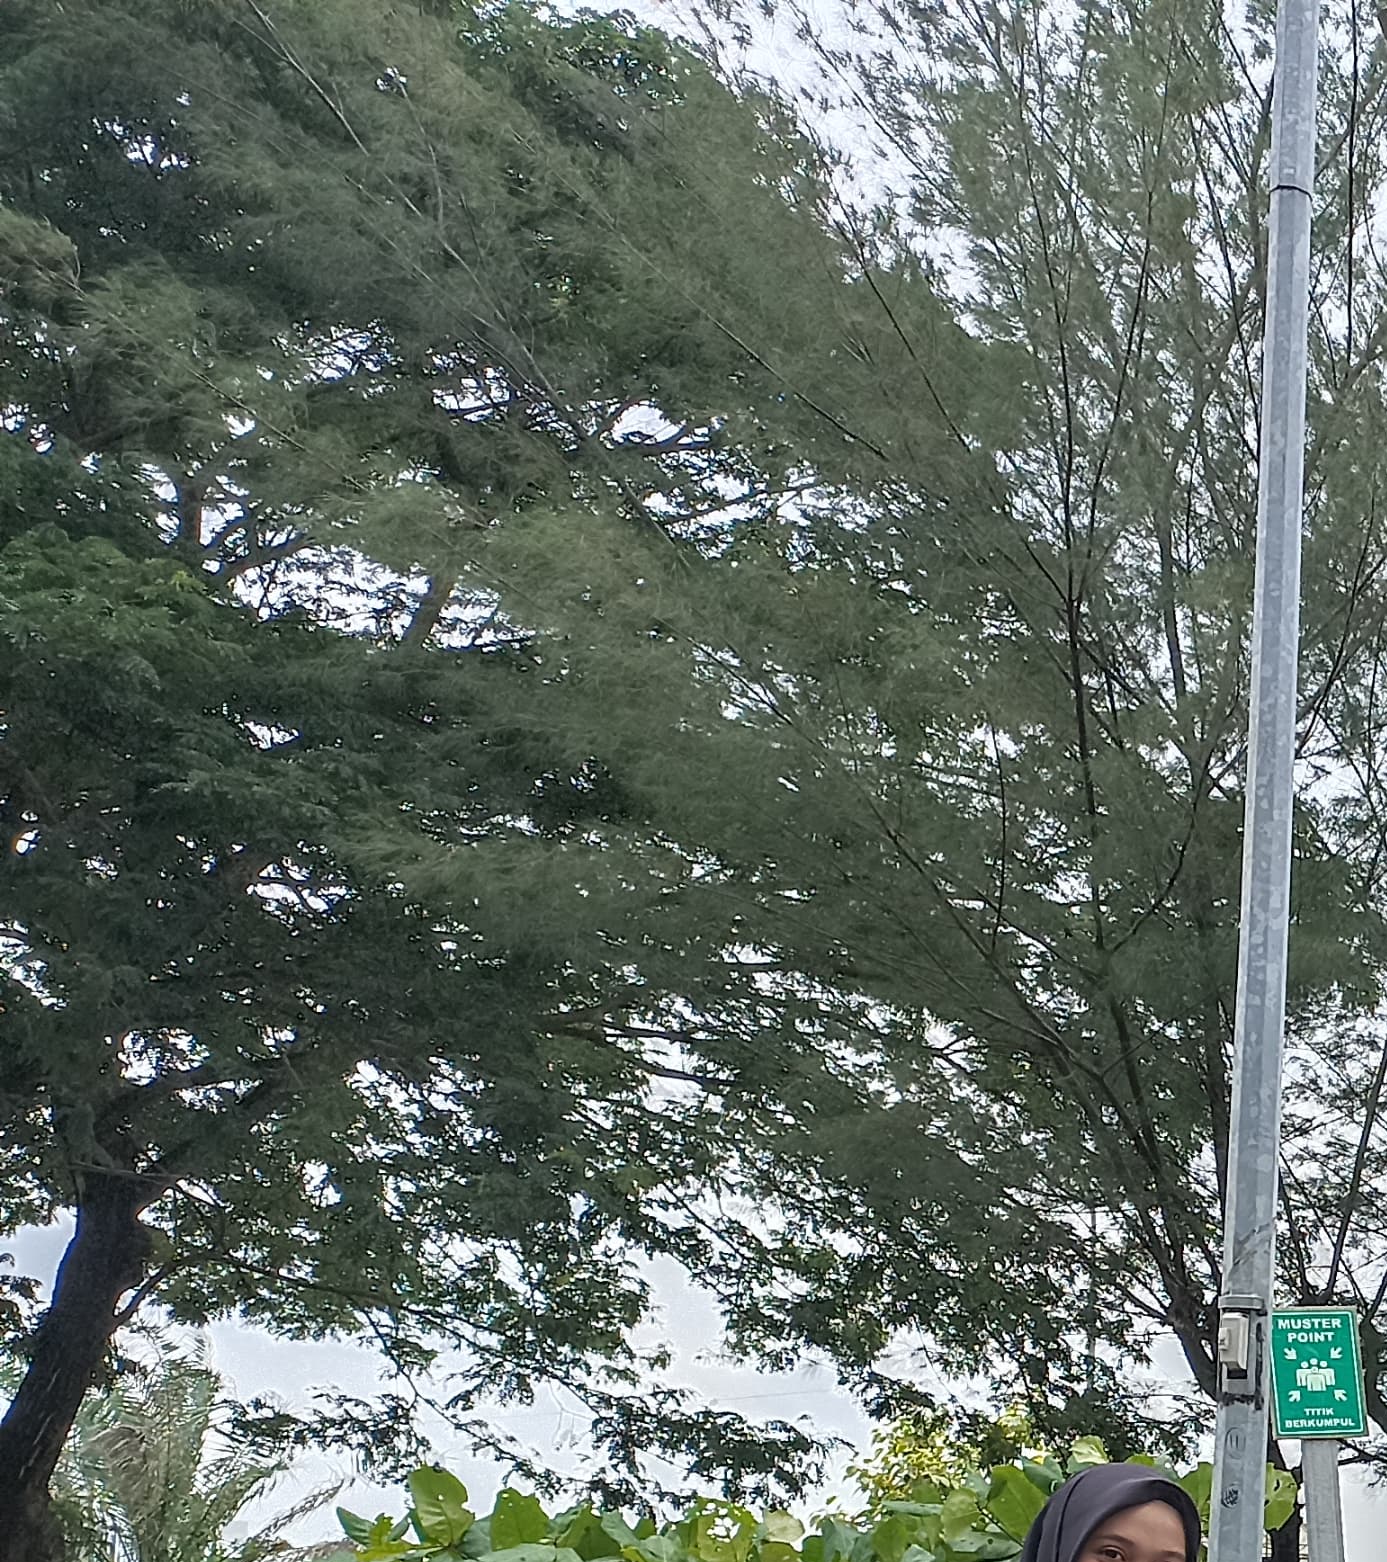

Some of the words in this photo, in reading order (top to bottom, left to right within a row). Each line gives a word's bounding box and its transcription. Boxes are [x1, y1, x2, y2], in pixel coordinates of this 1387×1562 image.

[1278, 1318, 1342, 1330] MUSTER
[1287, 1331, 1335, 1343] POINT
[1303, 1407, 1334, 1416] TITIK
[1285, 1418, 1355, 1428] BERKUMPUL
